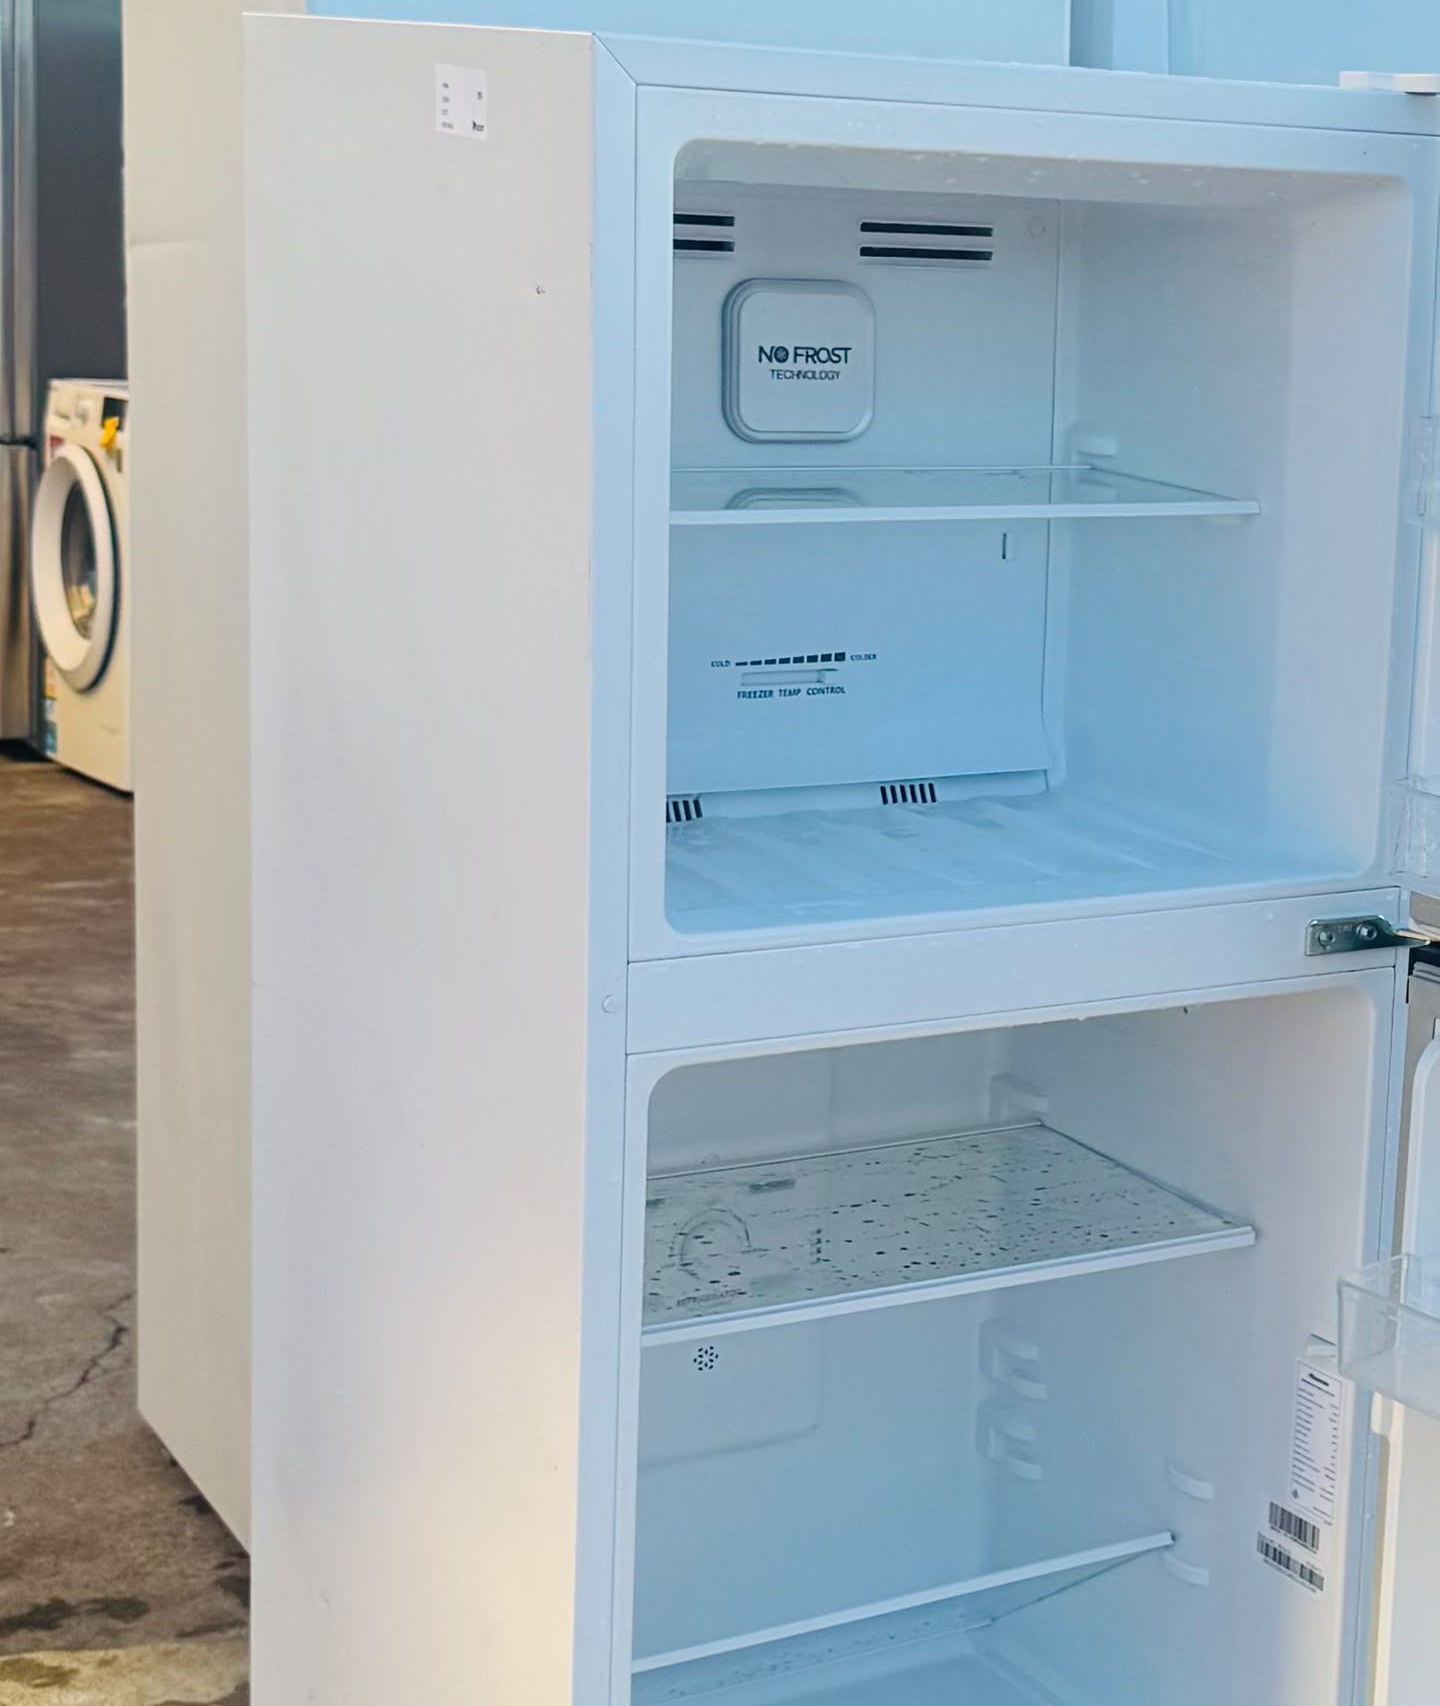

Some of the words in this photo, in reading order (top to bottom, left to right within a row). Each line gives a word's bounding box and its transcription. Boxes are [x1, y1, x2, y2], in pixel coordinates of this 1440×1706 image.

[758, 346, 789, 363] NO
[793, 346, 852, 364] FROST
[770, 368, 840, 380] TECHNOLOGY
[850, 653, 877, 661] COLDER
[711, 659, 731, 668] COLD
[737, 690, 774, 699] FREEZER
[778, 688, 801, 697] TEMP
[806, 686, 846, 696] CONTROL
